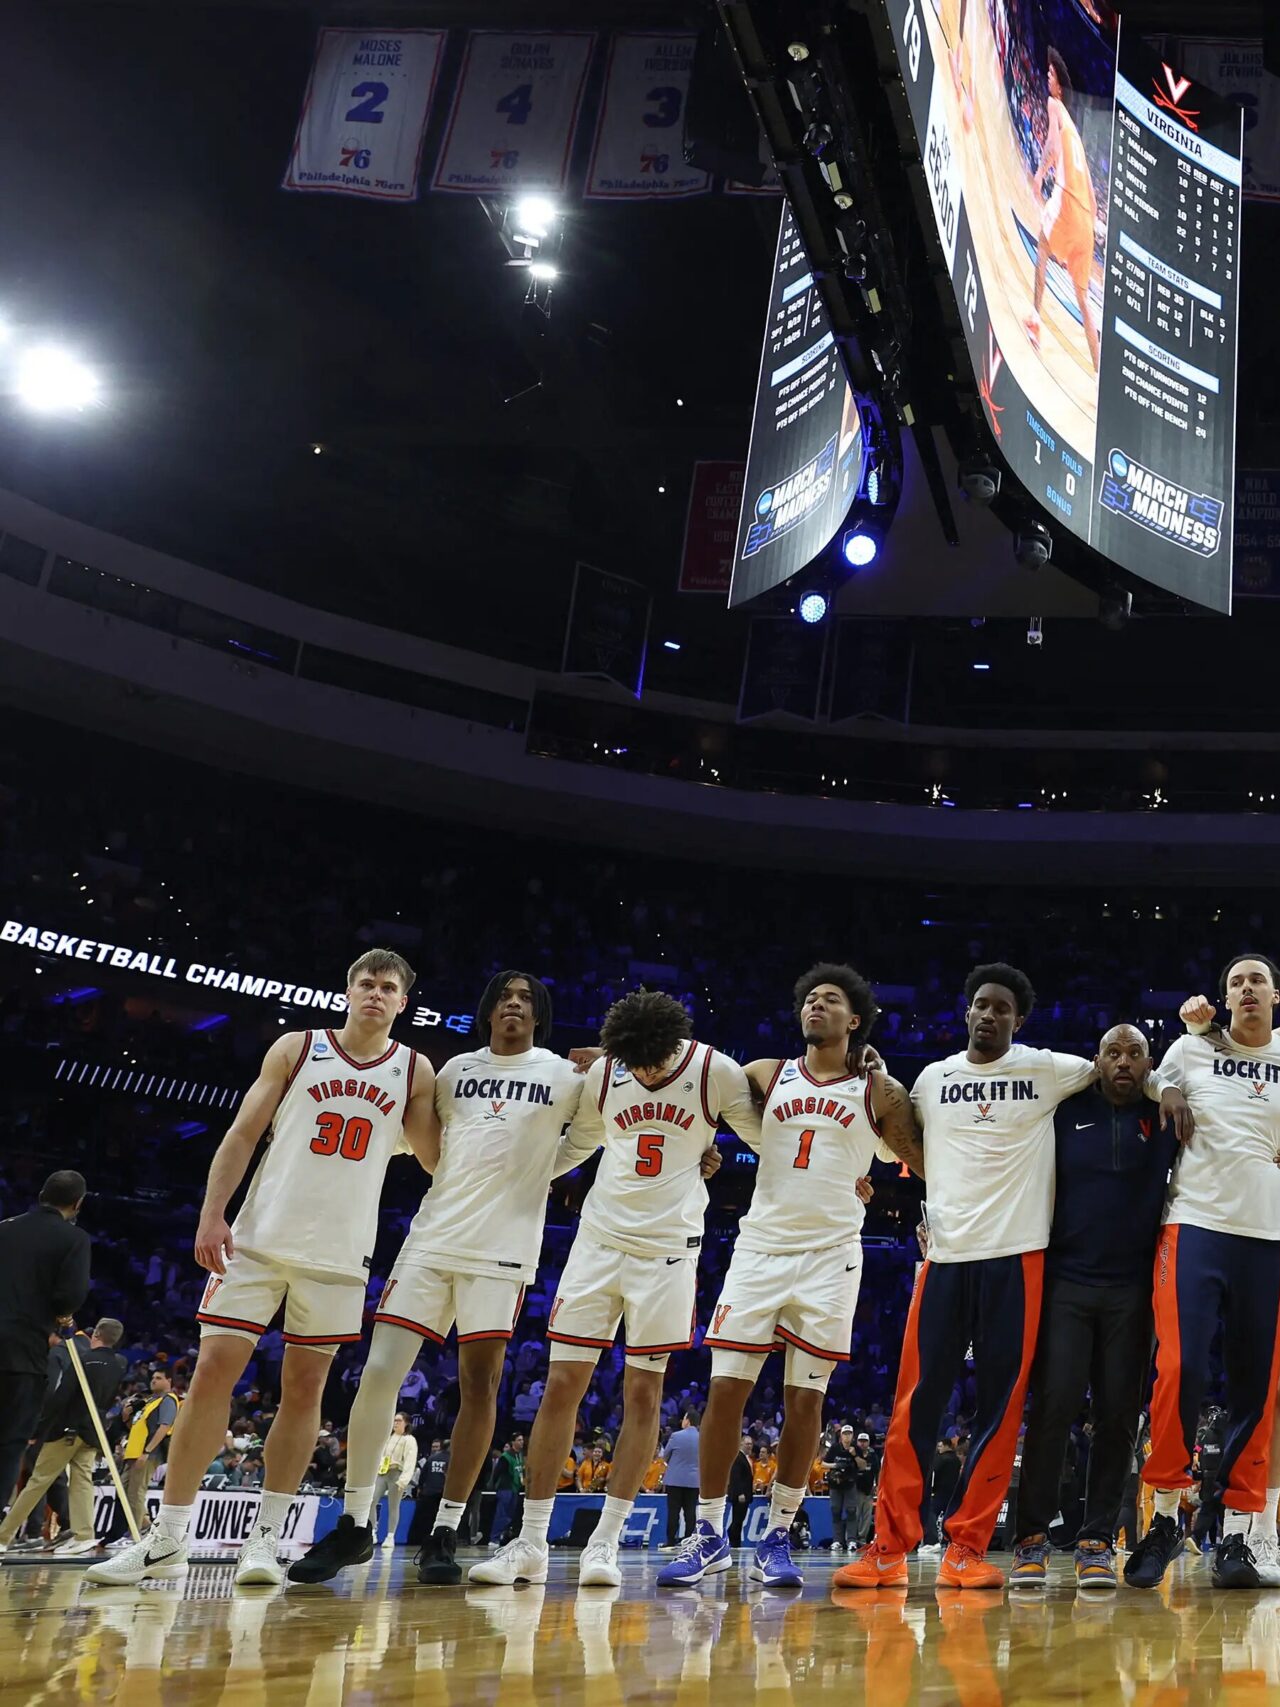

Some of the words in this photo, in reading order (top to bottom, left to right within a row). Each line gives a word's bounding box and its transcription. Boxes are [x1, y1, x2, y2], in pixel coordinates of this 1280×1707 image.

[353, 53, 402, 66] MALONE
[360, 40, 402, 52] MOSES
[345, 82, 389, 123] 2
[496, 84, 532, 124] 4
[643, 86, 681, 128] 3
[1147, 108, 1203, 158] VIRGINIA
[339, 147, 371, 169] 76
[490, 151, 519, 169] 76
[640, 154, 668, 173] 76
[299, 172, 370, 187] Philadelphia
[375, 179, 405, 190] 76ers
[1178, 158, 1191, 173] PTS
[1210, 178, 1224, 192] AST
[1179, 176, 1188, 188] 10
[1177, 226, 1187, 239] 22
[1147, 256, 1166, 275] TEAM
[1167, 270, 1189, 289] STATS
[1157, 300, 1170, 315] AST
[1174, 309, 1183, 323] 12
[1157, 317, 1170, 332] STL
[1200, 308, 1214, 323] BLK
[1148, 344, 1181, 371] SCORING
[1122, 366, 1135, 382] 2ND
[1136, 374, 1162, 399] CHANCE
[1162, 391, 1189, 413] POINTS
[1124, 349, 1137, 365] PTS
[1137, 358, 1150, 373] OFF
[1149, 366, 1190, 397] TURNOVERS
[1197, 392, 1207, 405] 12
[1124, 385, 1137, 401] PTS
[1138, 394, 1150, 409] OFF
[1151, 403, 1164, 418] THE
[1164, 410, 1188, 431] BENCH
[1195, 426, 1206, 439] 24
[1026, 410, 1056, 452] TIMEOUTS
[1034, 440, 1041, 465] 1
[1061, 450, 1084, 478] FOULS
[771, 459, 818, 512] MARCH
[773, 467, 832, 531] MADNESS
[1046, 484, 1072, 517] BONUS
[1065, 473, 1076, 496] 0
[1126, 463, 1188, 514] MARCH
[1131, 492, 1218, 550] MADNESS
[1, 921, 179, 979] BASKETBALL
[1213, 1058, 1262, 1080] LOCK
[1265, 1063, 1280, 1083] IT
[307, 1078, 397, 1117] VIRGINIA
[455, 1078, 504, 1099] LOCK
[506, 1080, 528, 1102] IT
[529, 1084, 554, 1106] IN.
[940, 1082, 985, 1104] LOCK
[989, 1080, 1009, 1101] IT
[1011, 1080, 1039, 1101] IN.
[613, 1102, 696, 1131] VIRGINIA
[772, 1097, 856, 1129] VIRGINIA
[310, 1111, 373, 1161] 30
[793, 1129, 816, 1169] 1
[635, 1134, 665, 1177] 5
[735, 1153, 756, 1165] FT%
